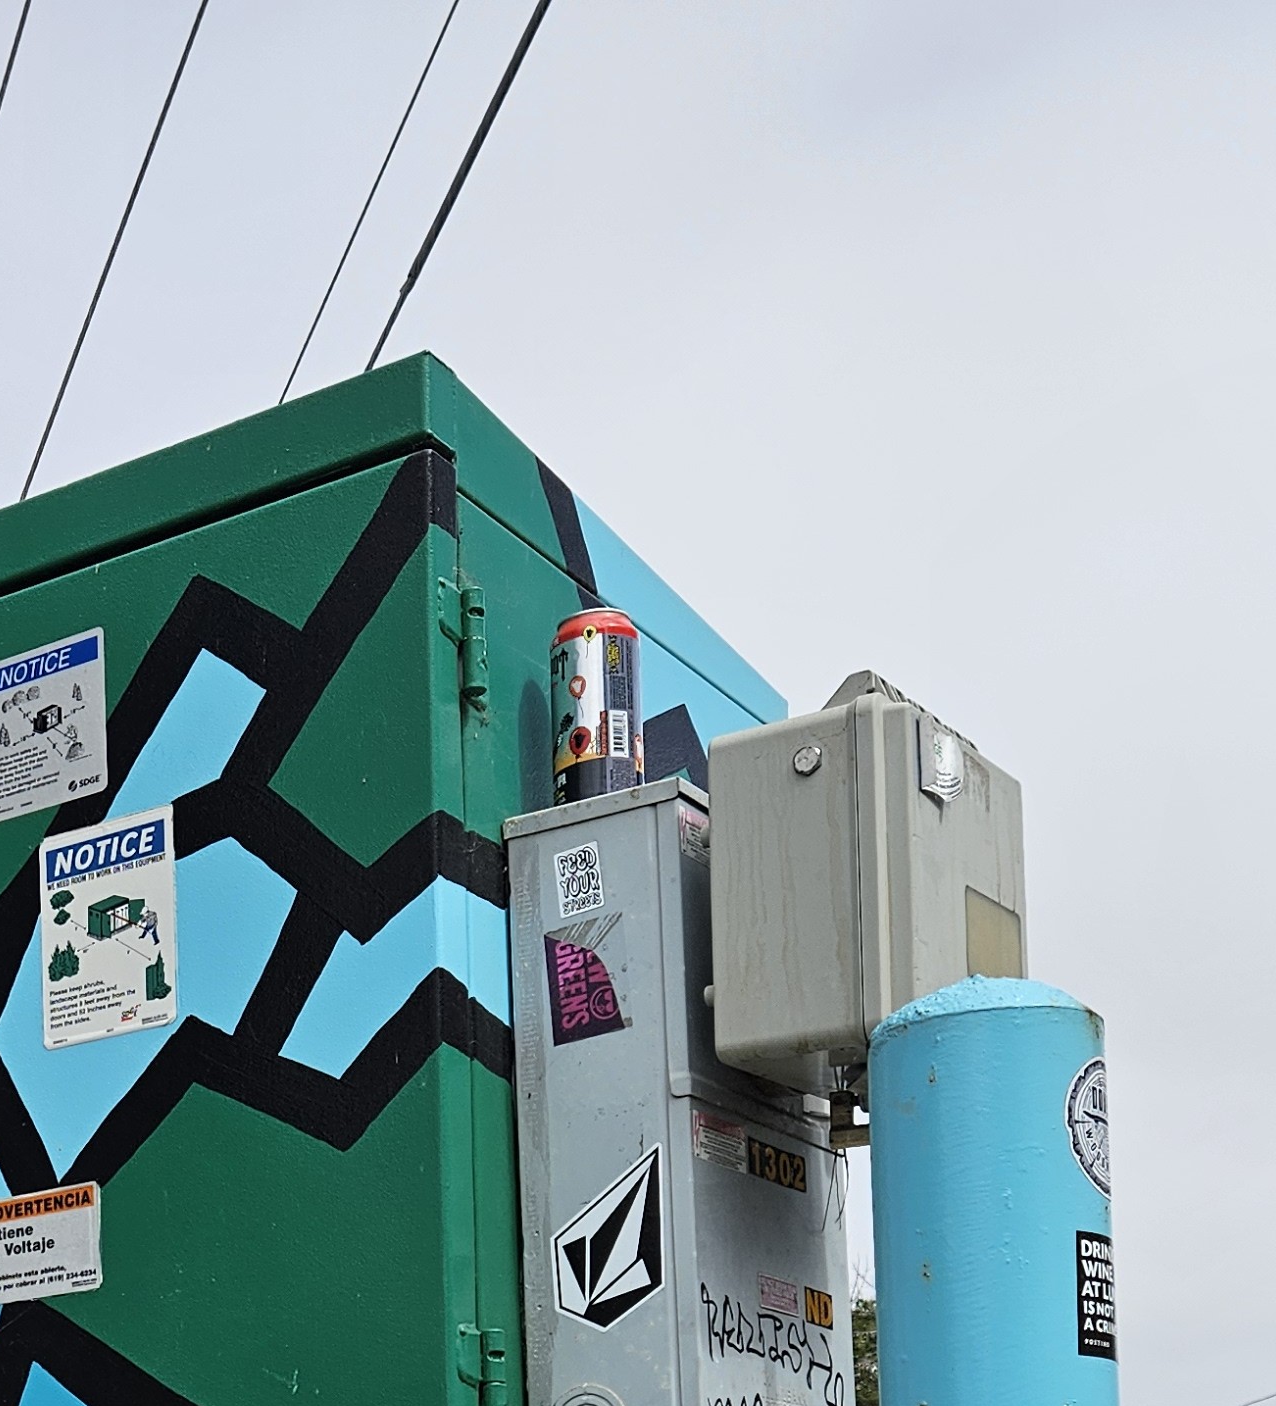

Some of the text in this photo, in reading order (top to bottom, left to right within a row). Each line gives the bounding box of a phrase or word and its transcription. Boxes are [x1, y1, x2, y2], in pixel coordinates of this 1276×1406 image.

[0, 648, 72, 688] NOTICE
[54, 826, 155, 877] NOTICE
[557, 846, 597, 877] FEED
[56, 880, 69, 889] NEED
[71, 875, 86, 885] ROOM
[88, 872, 94, 881] TO
[96, 868, 111, 878] WORK
[112, 865, 120, 873] ON
[122, 861, 134, 871] THIS
[135, 853, 166, 868] EQUIPMENT
[559, 867, 600, 898] YOUR
[562, 891, 603, 915] STREETS
[49, 988, 68, 997] Please
[69, 985, 83, 993] keep
[50, 984, 117, 1005] landscape materials and
[555, 940, 590, 1030] GREENS
[50, 1003, 78, 1013] structures
[84, 998, 95, 1006] feet
[96, 995, 111, 1004] away
[112, 990, 125, 999] from
[127, 988, 136, 996] the
[50, 1012, 66, 1021] doors
[67, 1009, 78, 1018] and
[87, 1004, 106, 1013] inches
[107, 1001, 122, 1010] away
[51, 1021, 63, 1030] from
[750, 1140, 805, 1190] 1302
[4, 1237, 55, 1256] Voltaje
[1080, 1239, 1113, 1261] DRIN
[1081, 1259, 1113, 1282] WINE
[3, 1284, 14, 1292] por
[15, 1279, 37, 1288] cobrar
[39, 1277, 46, 1285] al
[47, 1275, 64, 1285] (619)
[1081, 1280, 1101, 1298] AT
[806, 1288, 833, 1327] ND
[1083, 1300, 1114, 1319] IS NOT
[1084, 1317, 1094, 1331] A
